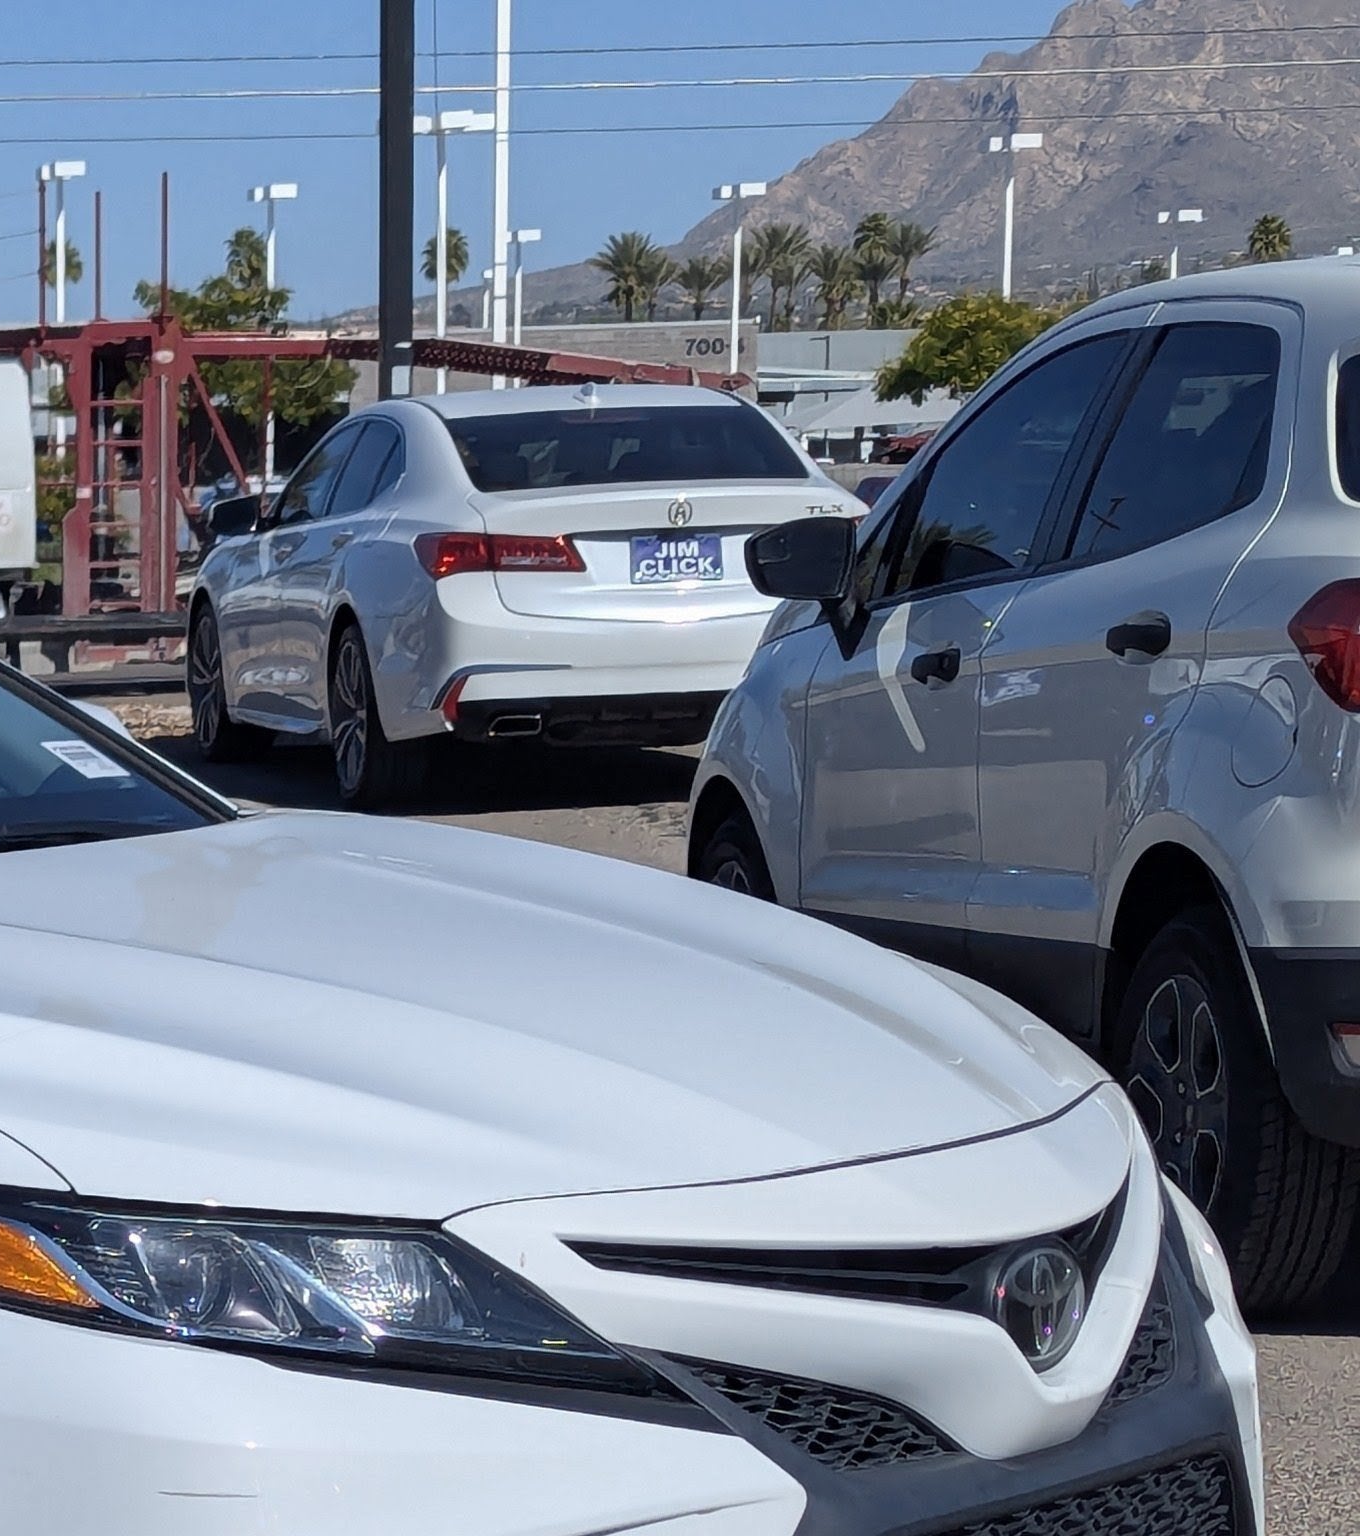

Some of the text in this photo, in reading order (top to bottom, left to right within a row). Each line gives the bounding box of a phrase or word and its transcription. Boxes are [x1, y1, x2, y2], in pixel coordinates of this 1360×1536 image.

[805, 504, 844, 515] TLX
[654, 540, 699, 558] JIM
[639, 557, 715, 576] CLICK
